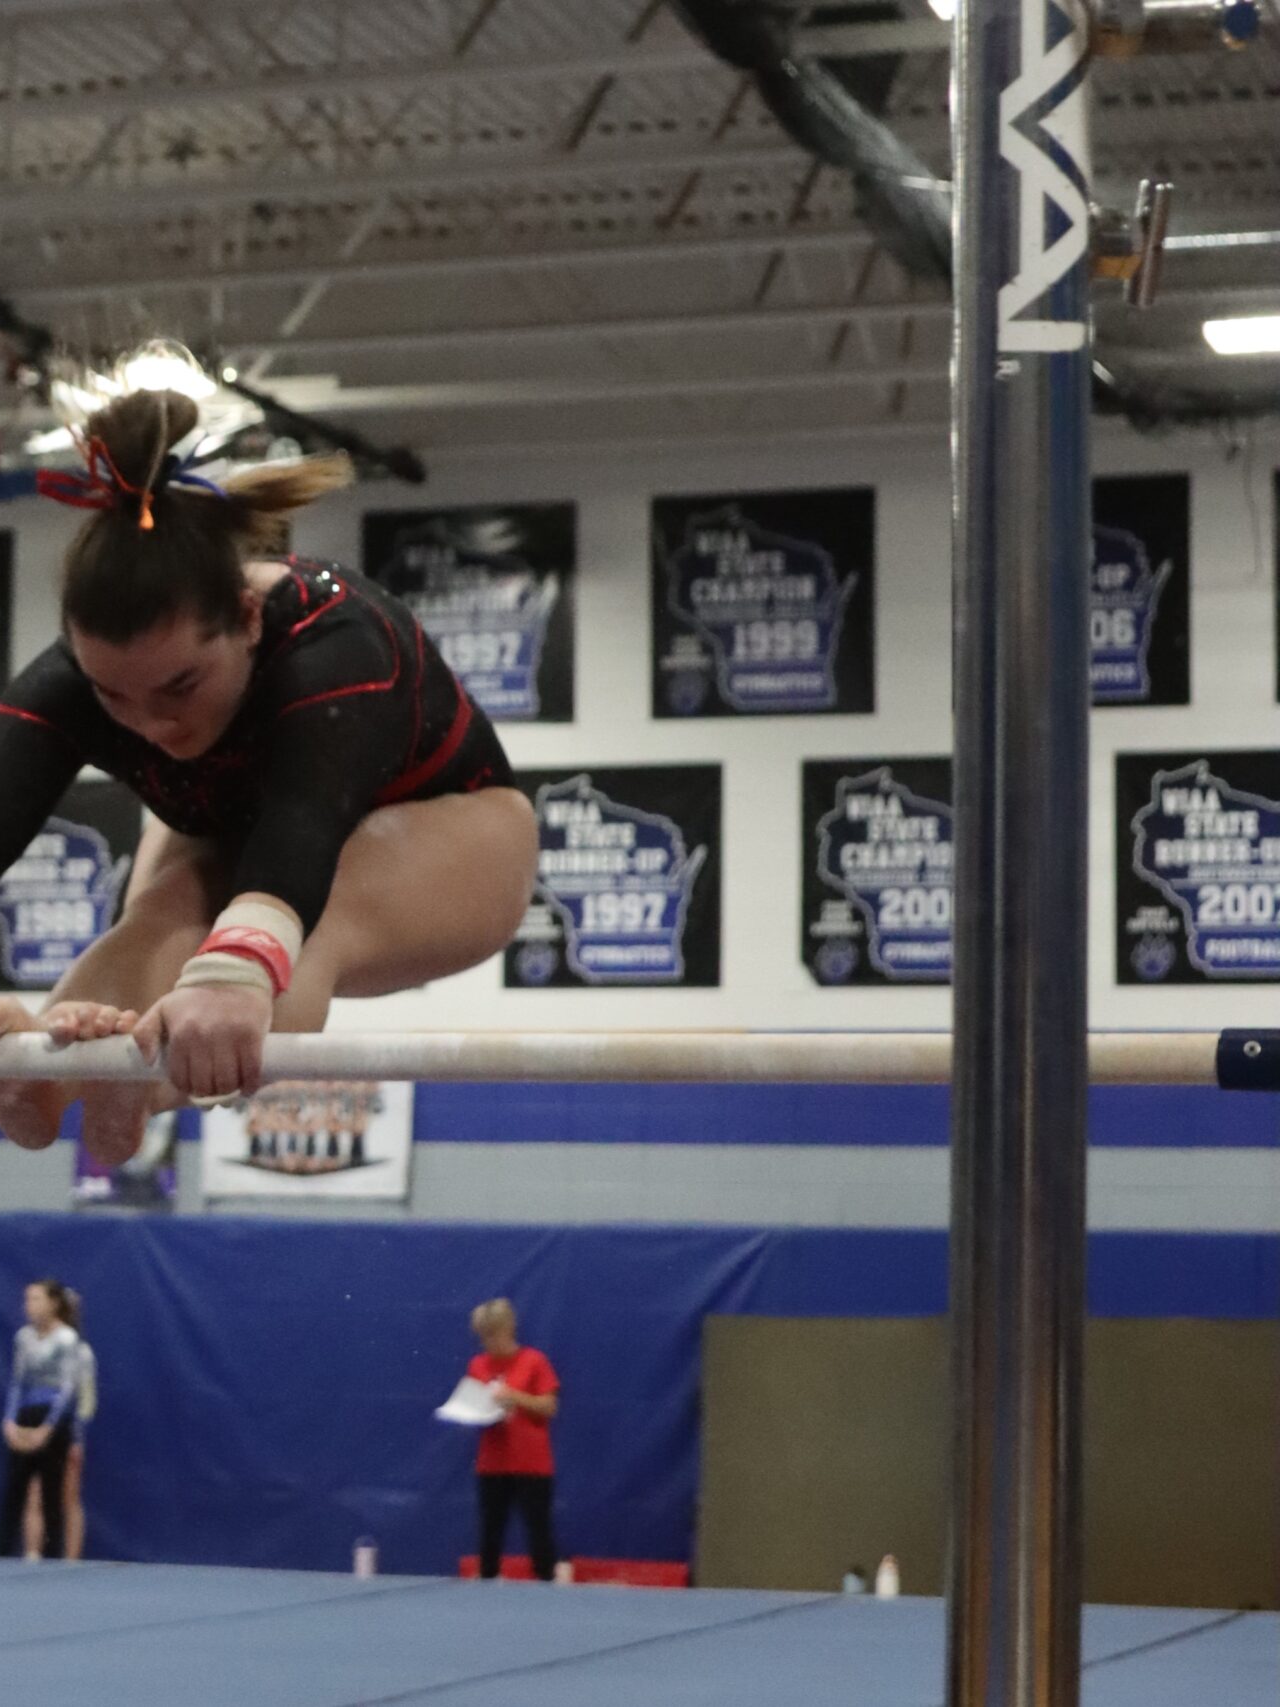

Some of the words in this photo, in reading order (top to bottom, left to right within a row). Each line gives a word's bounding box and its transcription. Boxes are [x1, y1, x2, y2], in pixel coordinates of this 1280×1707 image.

[732, 620, 819, 663] 1999
[1184, 811, 1260, 839] STATE
[839, 842, 953, 870] CHAMPIO
[1154, 837, 1280, 868] RUNNER-U
[580, 892, 669, 934] 1997
[878, 887, 952, 929] 200
